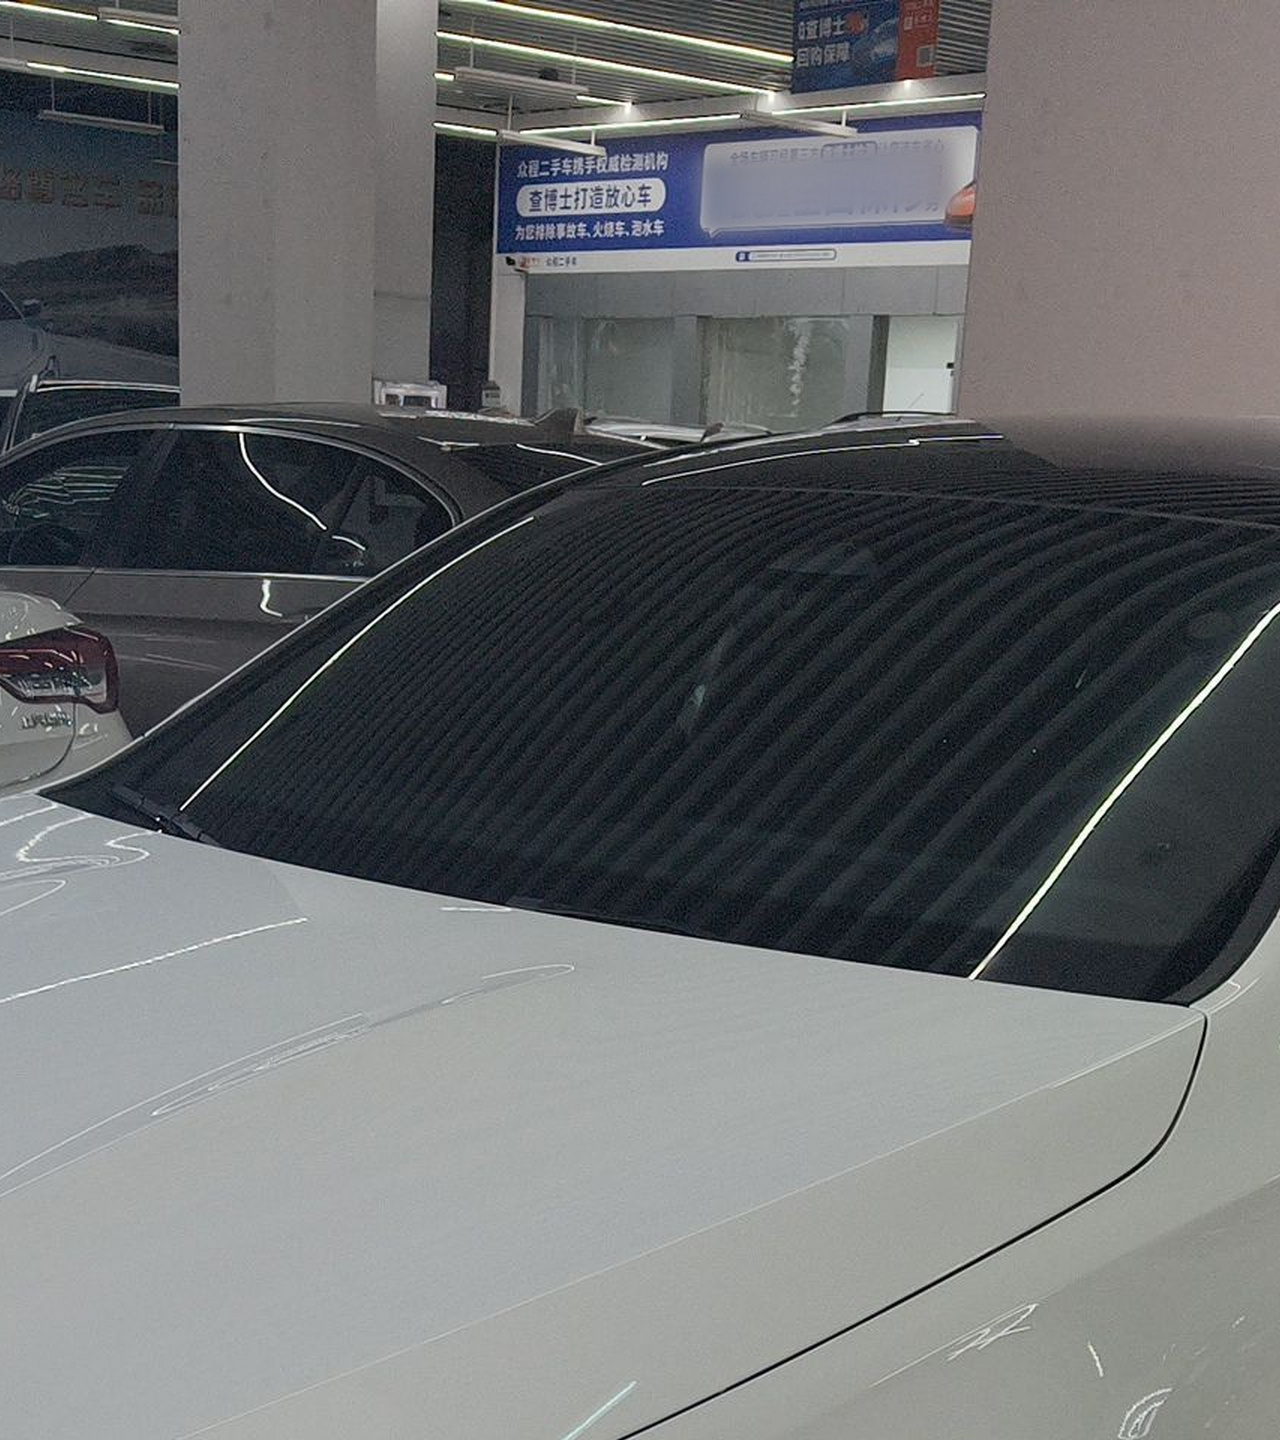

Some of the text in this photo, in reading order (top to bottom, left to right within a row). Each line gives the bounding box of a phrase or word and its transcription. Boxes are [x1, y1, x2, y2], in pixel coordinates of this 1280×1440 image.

[796, 41, 851, 68] 回购保障
[529, 184, 652, 213] 查博士打造放心车
